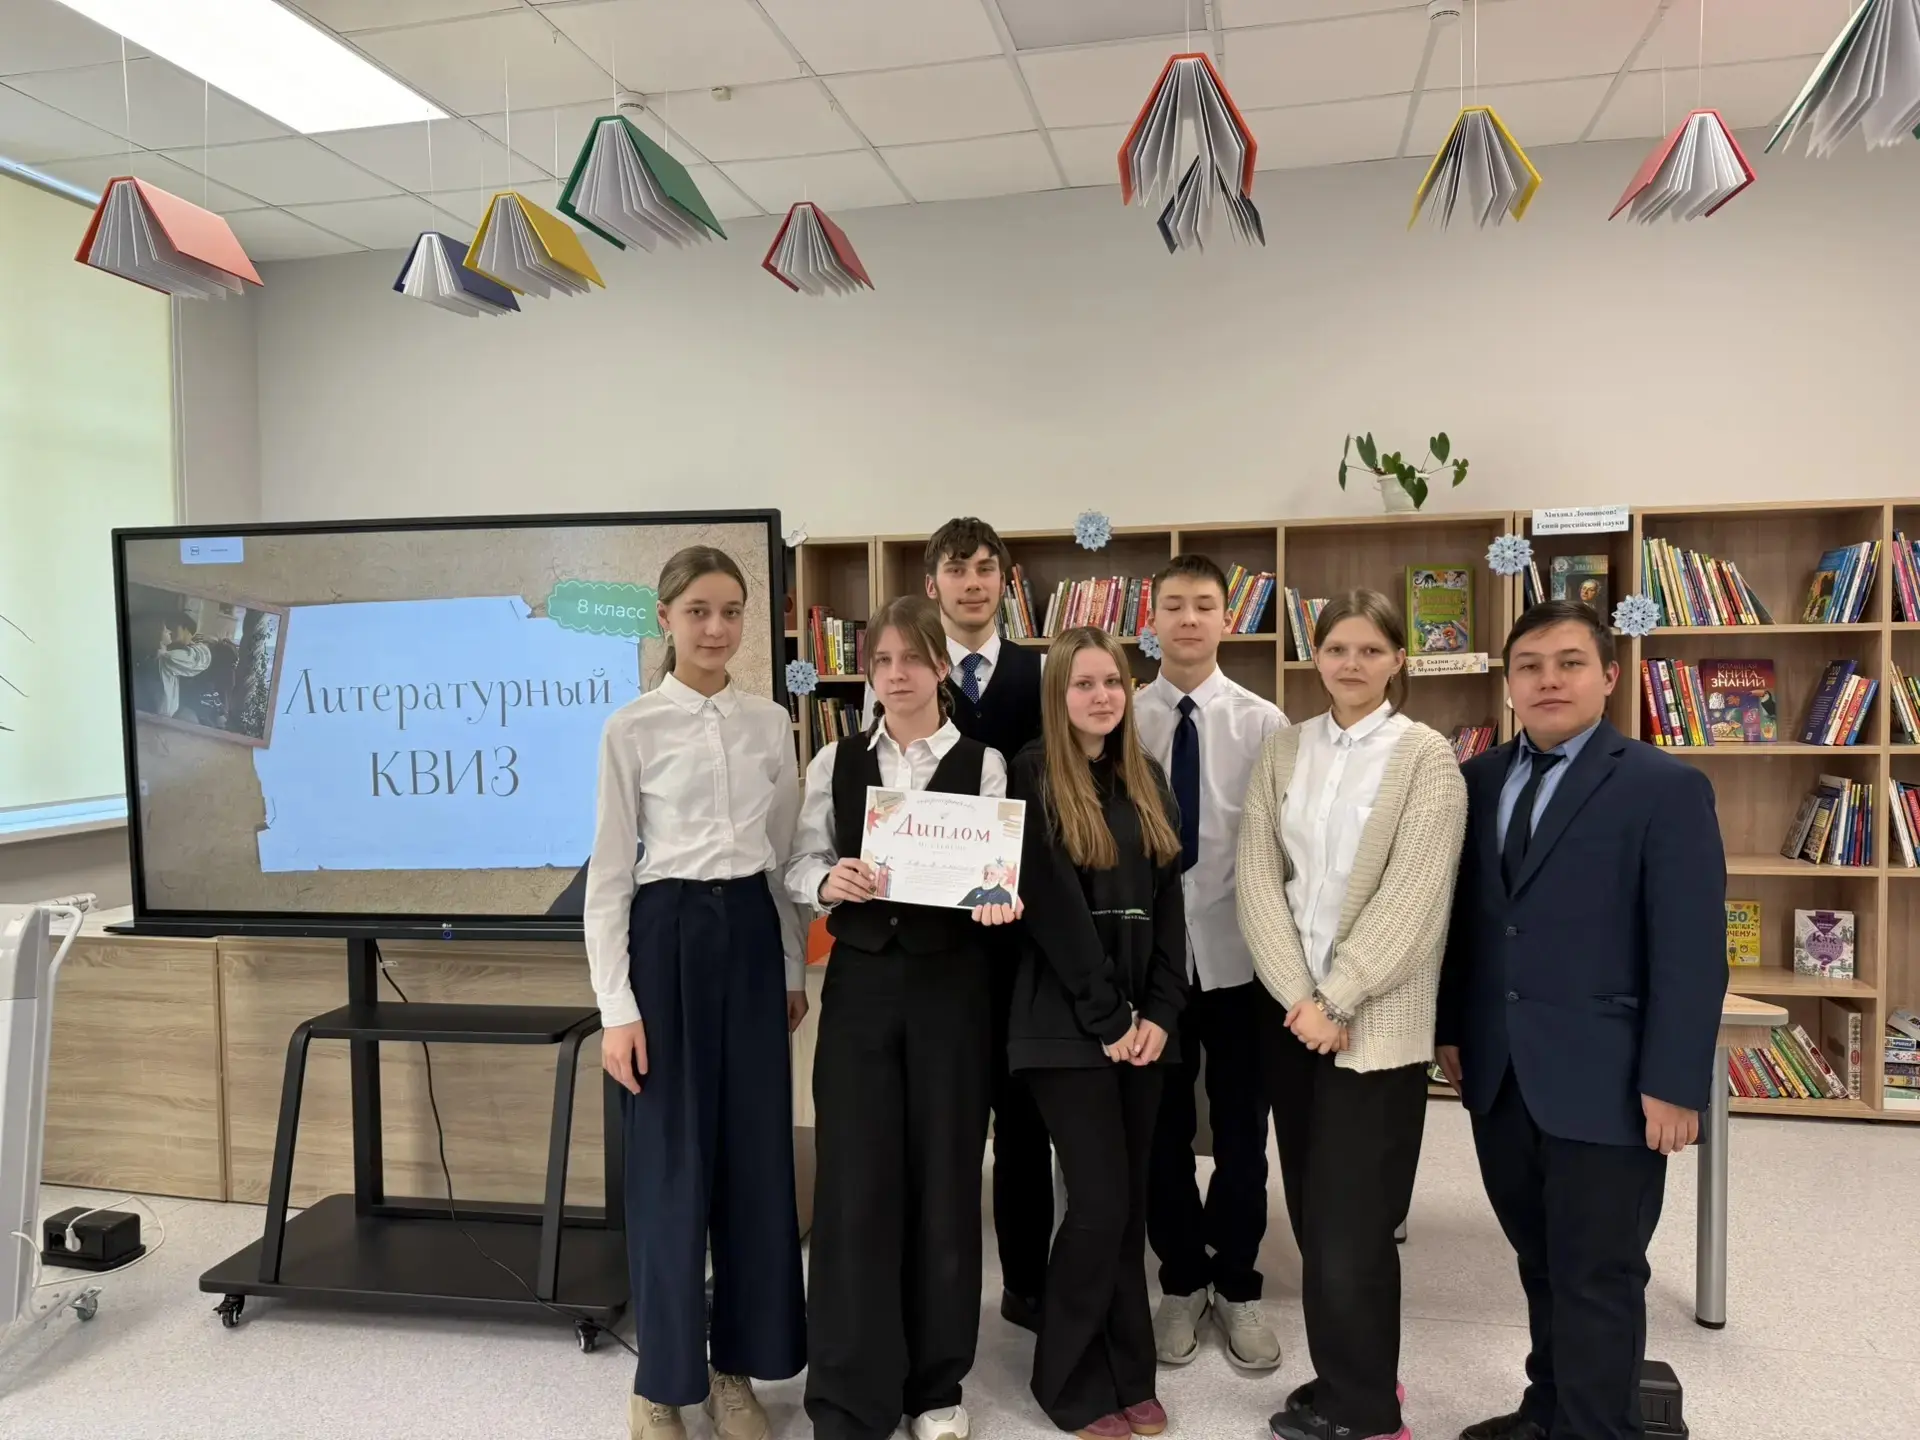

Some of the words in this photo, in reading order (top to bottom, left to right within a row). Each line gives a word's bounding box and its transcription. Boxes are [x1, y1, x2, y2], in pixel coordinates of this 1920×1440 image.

[1602, 520, 1625, 528] науки
[577, 599, 589, 614] 8
[594, 604, 647, 620] класс
[1711, 676, 1766, 688] ЗНАНИЙ
[1717, 669, 1764, 679] КНИГА
[282, 668, 615, 730] Литературный
[370, 745, 520, 797] КВИЗ
[892, 813, 991, 843] Диплом
